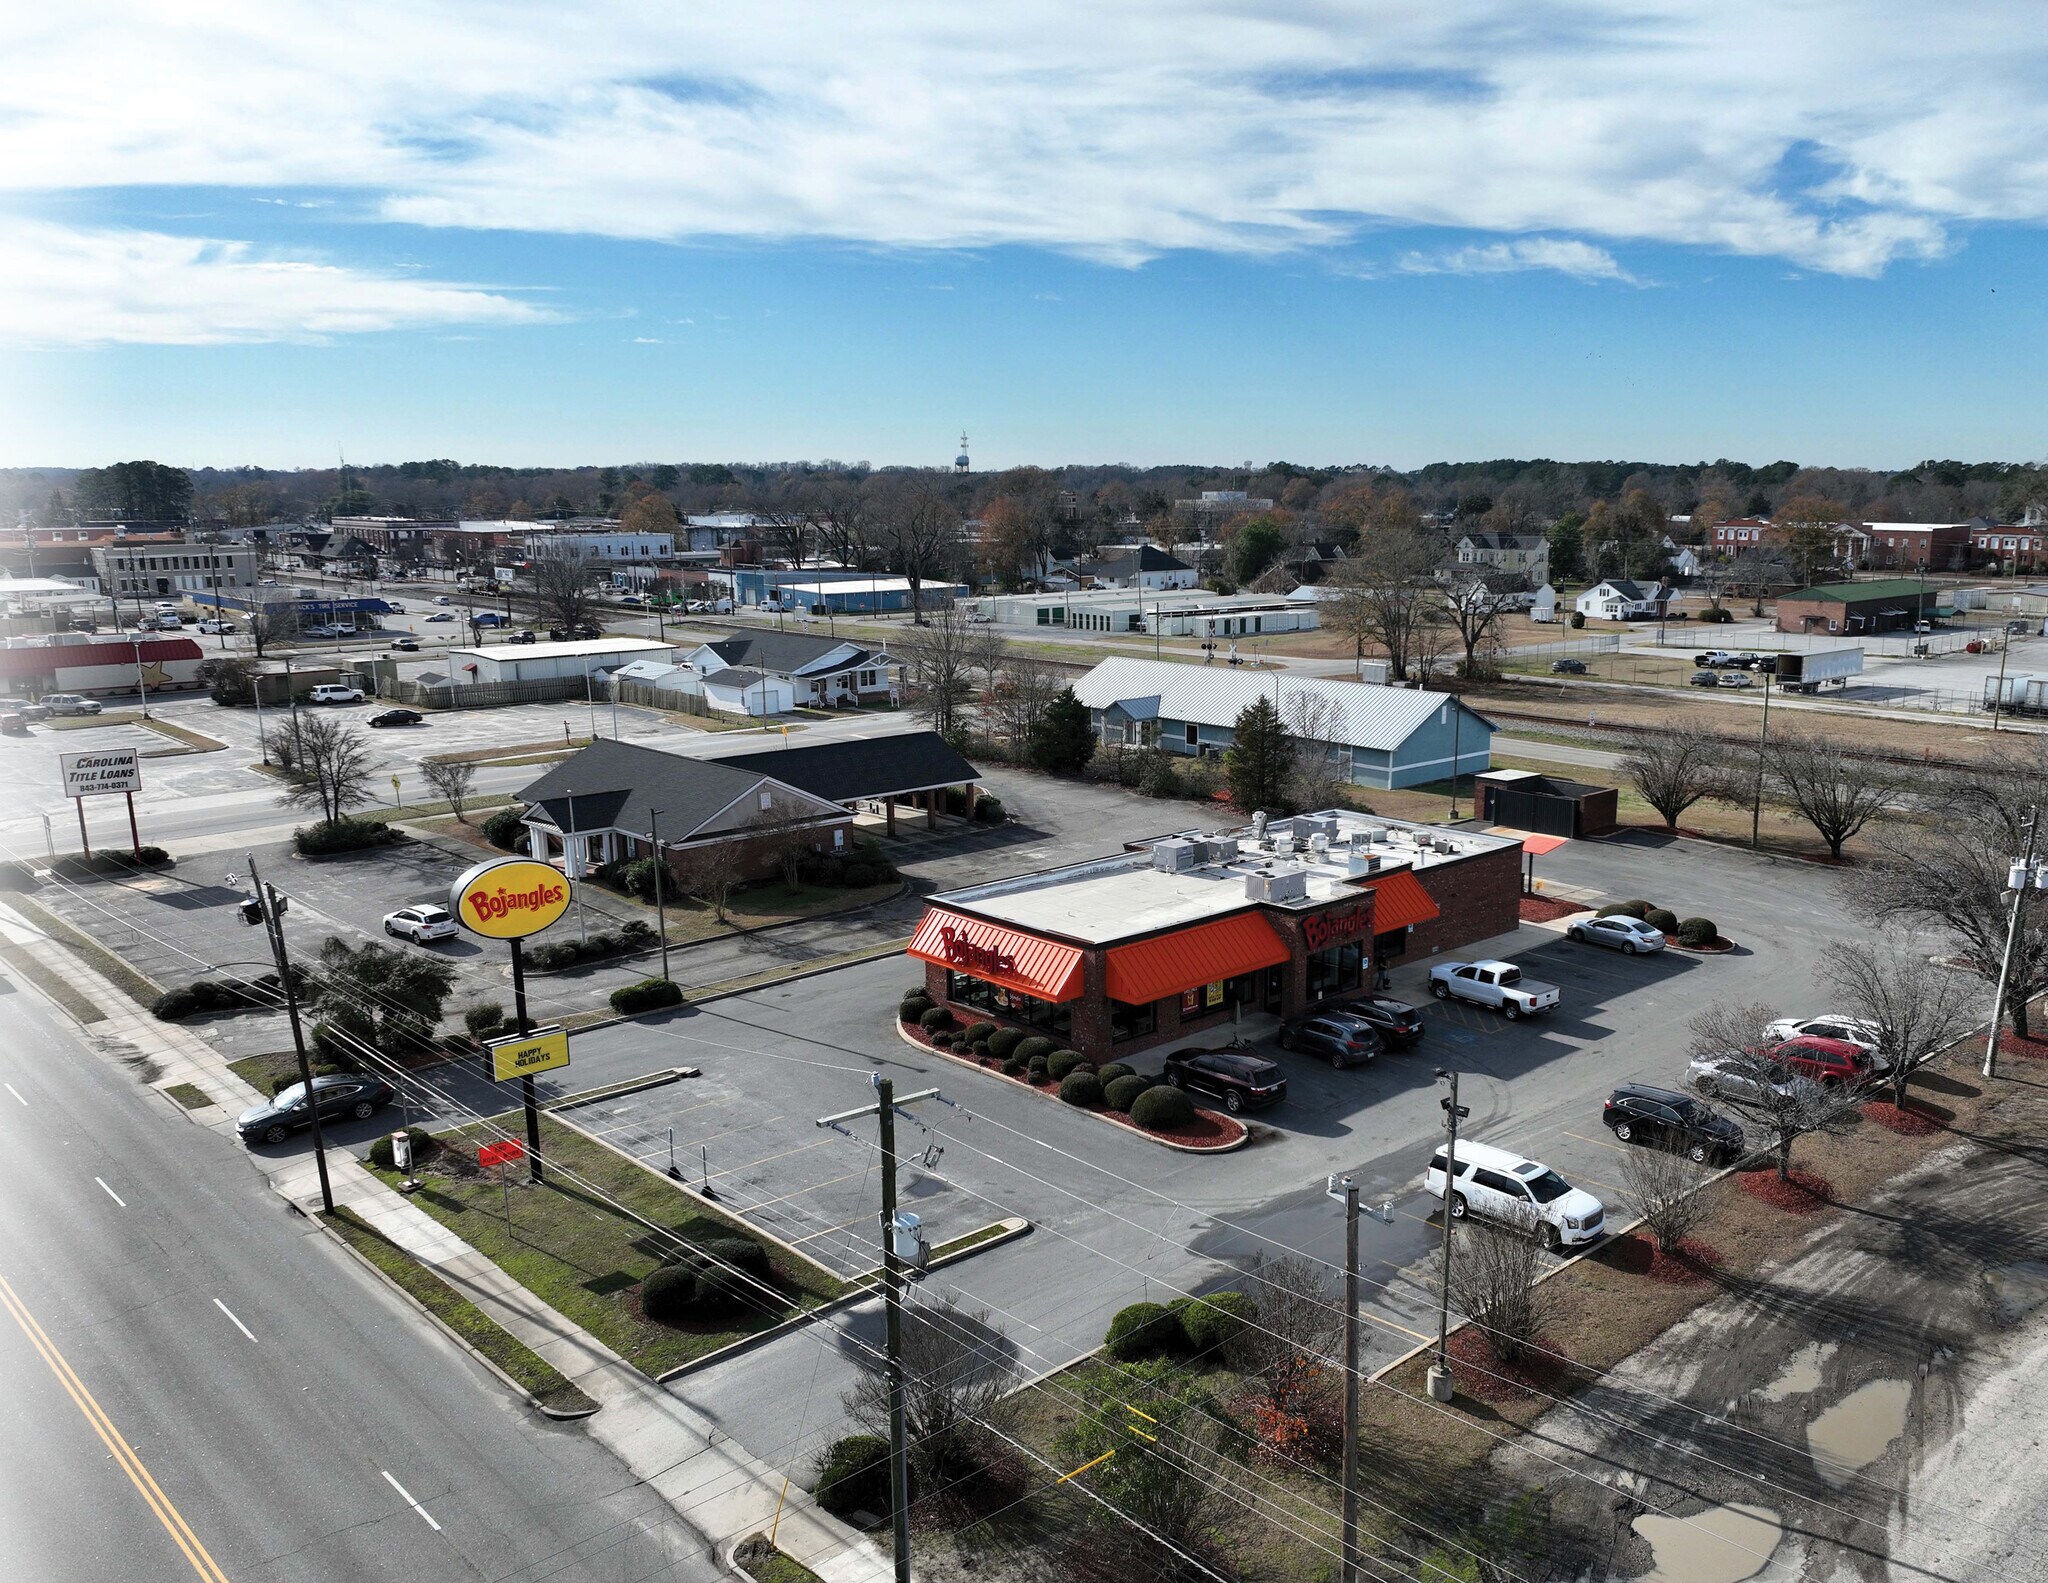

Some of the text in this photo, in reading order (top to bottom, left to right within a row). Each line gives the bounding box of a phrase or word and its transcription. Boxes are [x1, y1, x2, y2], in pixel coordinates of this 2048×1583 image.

[76, 756, 134, 769] CAROLINA
[69, 768, 135, 783] TITLE LOANS
[468, 883, 564, 923] Bojangles
[940, 926, 1015, 975] Bojangles
[514, 1053, 551, 1068] HOLIDAYS
[517, 1047, 542, 1059] HAPPY
